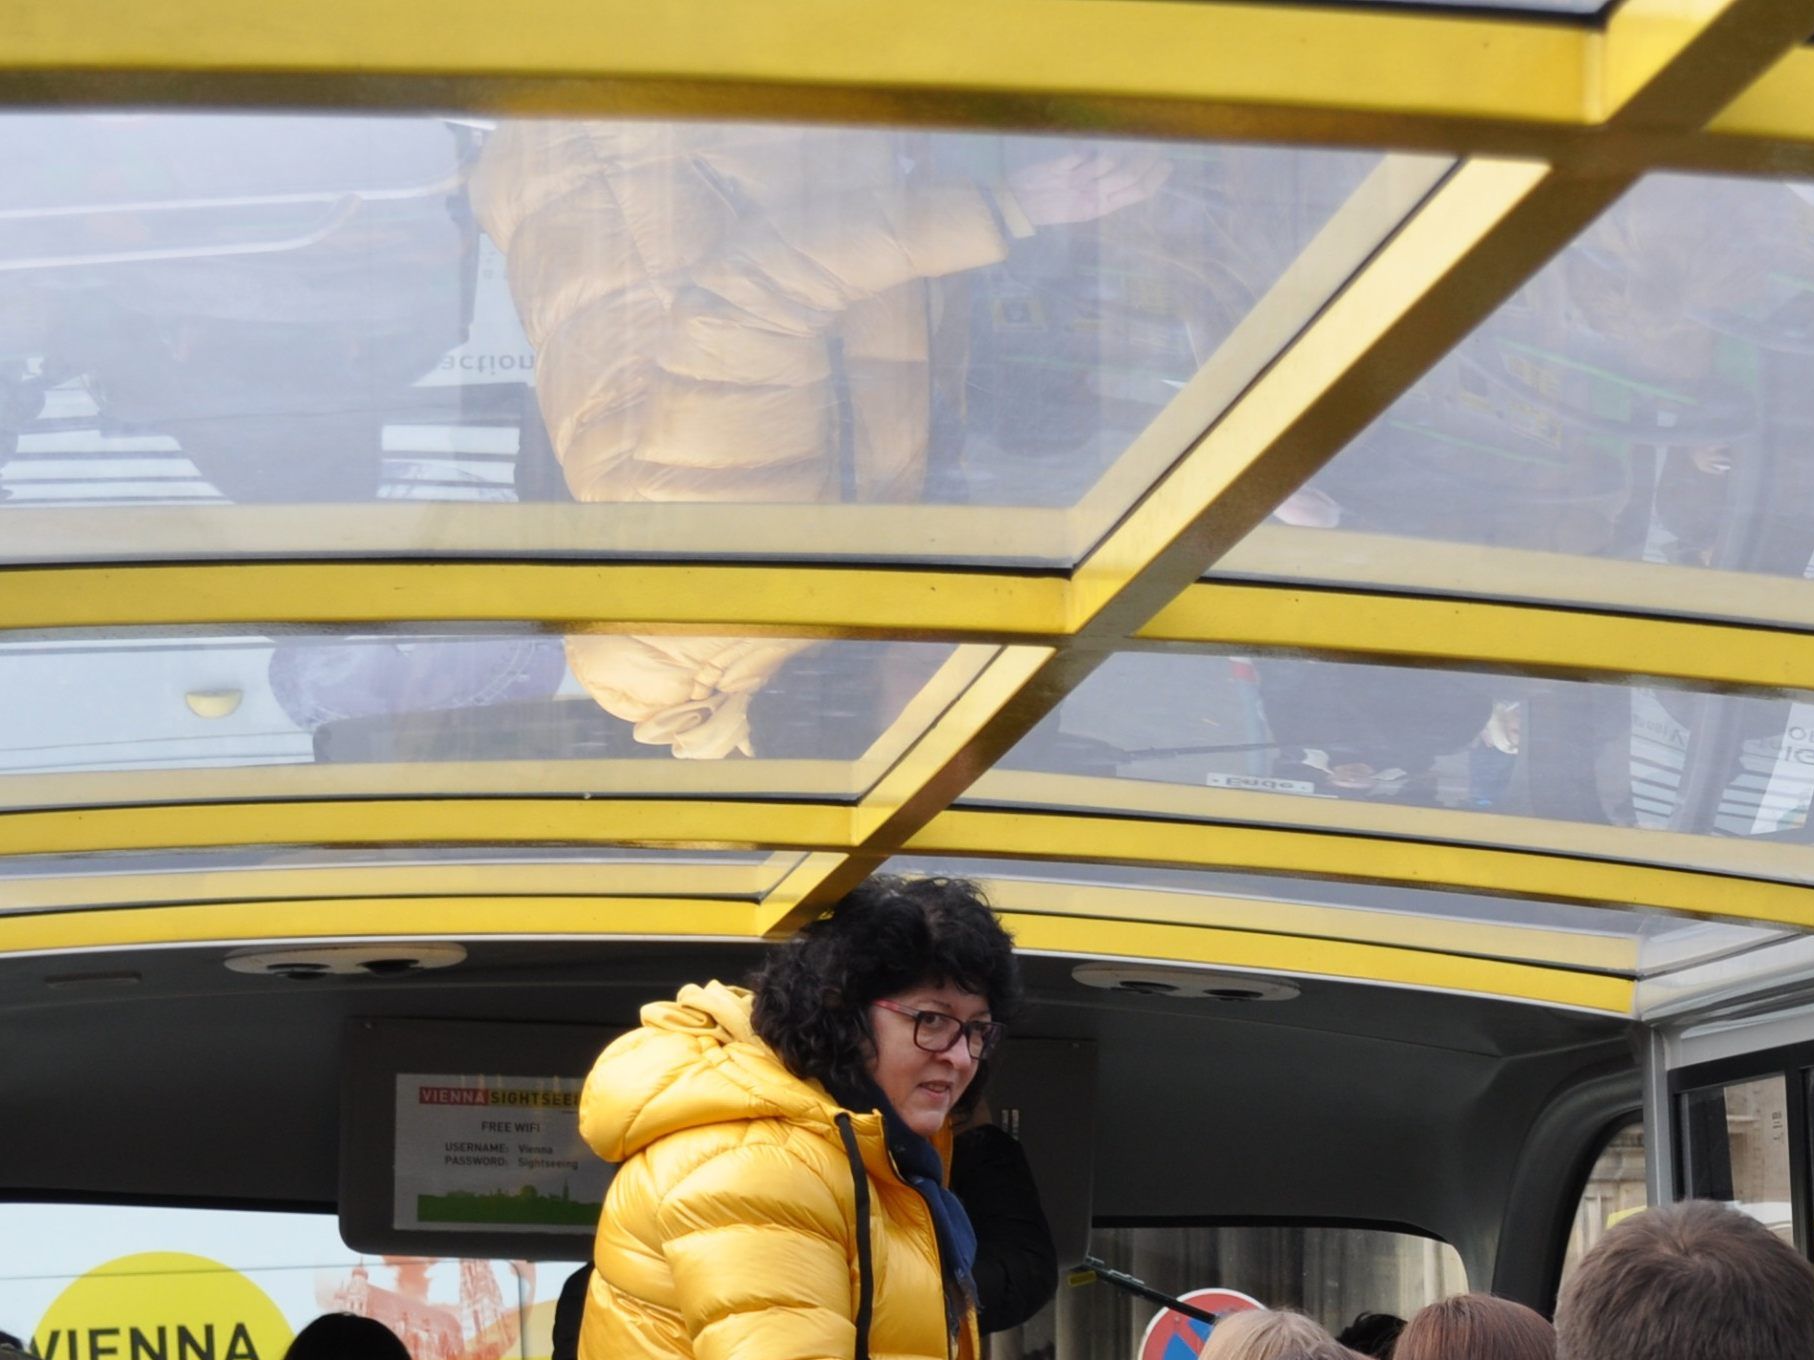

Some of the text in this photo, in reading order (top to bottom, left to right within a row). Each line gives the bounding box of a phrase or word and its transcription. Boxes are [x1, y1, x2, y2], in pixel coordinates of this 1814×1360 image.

[421, 1088, 578, 1107] VIENNA SIGHTSEEI
[481, 1121, 511, 1133] FREE
[444, 1142, 553, 1155] USERNAME: Vienna
[444, 1155, 579, 1171] PASSWORD: Sightseeing
